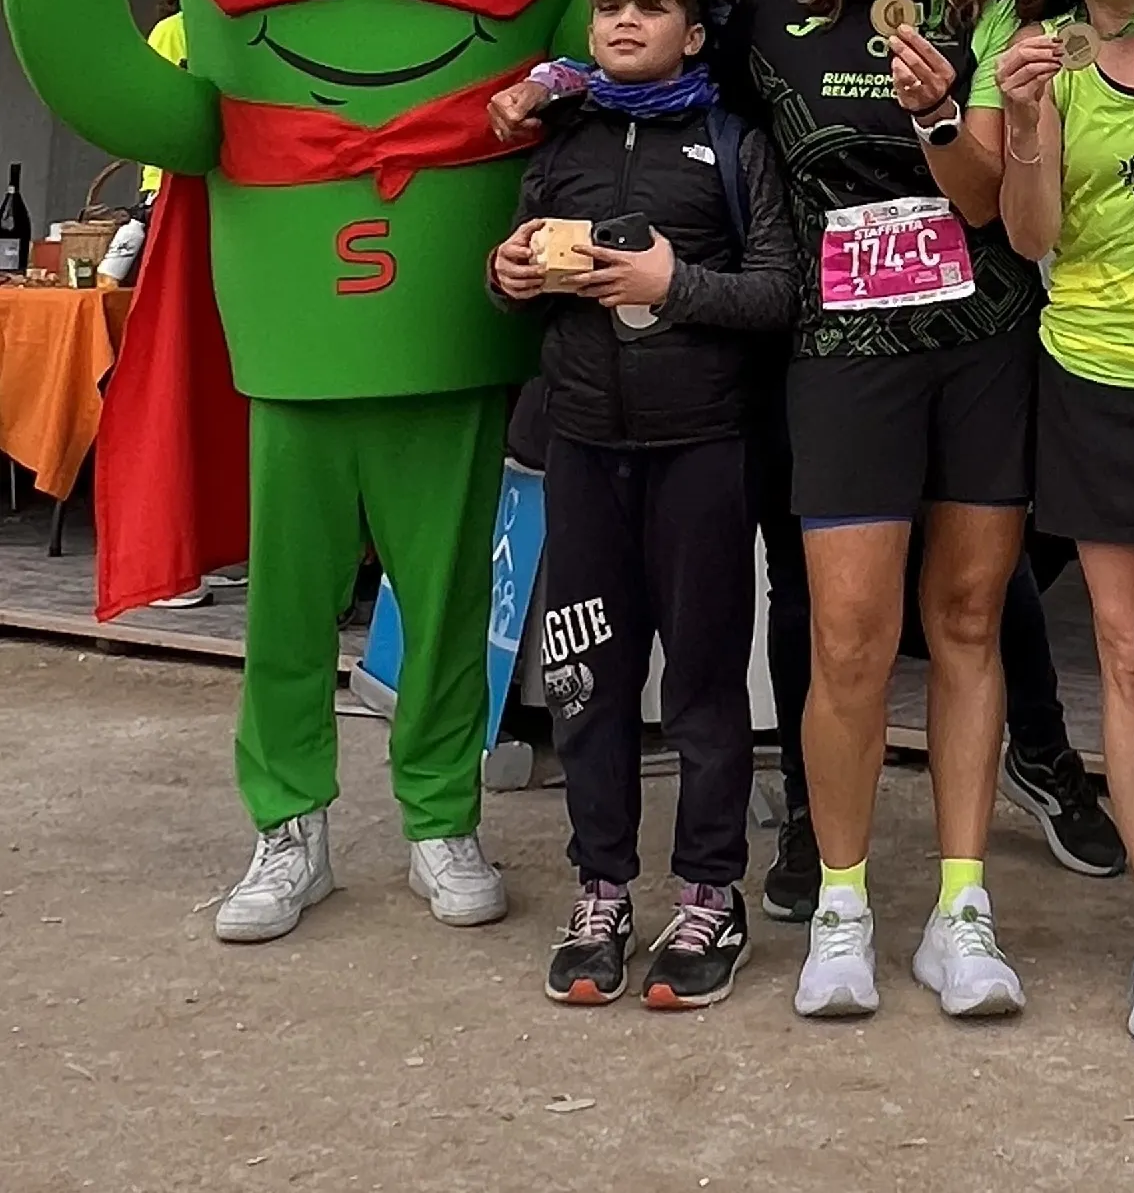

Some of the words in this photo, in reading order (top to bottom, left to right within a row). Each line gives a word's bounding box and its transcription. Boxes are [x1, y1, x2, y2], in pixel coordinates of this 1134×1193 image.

[821, 85, 869, 98] RELAY
[870, 87, 898, 100] RAC
[854, 219, 925, 241] STAFFETTA
[336, 218, 397, 296] S
[843, 228, 941, 278] 774-C
[853, 277, 868, 296] 2
